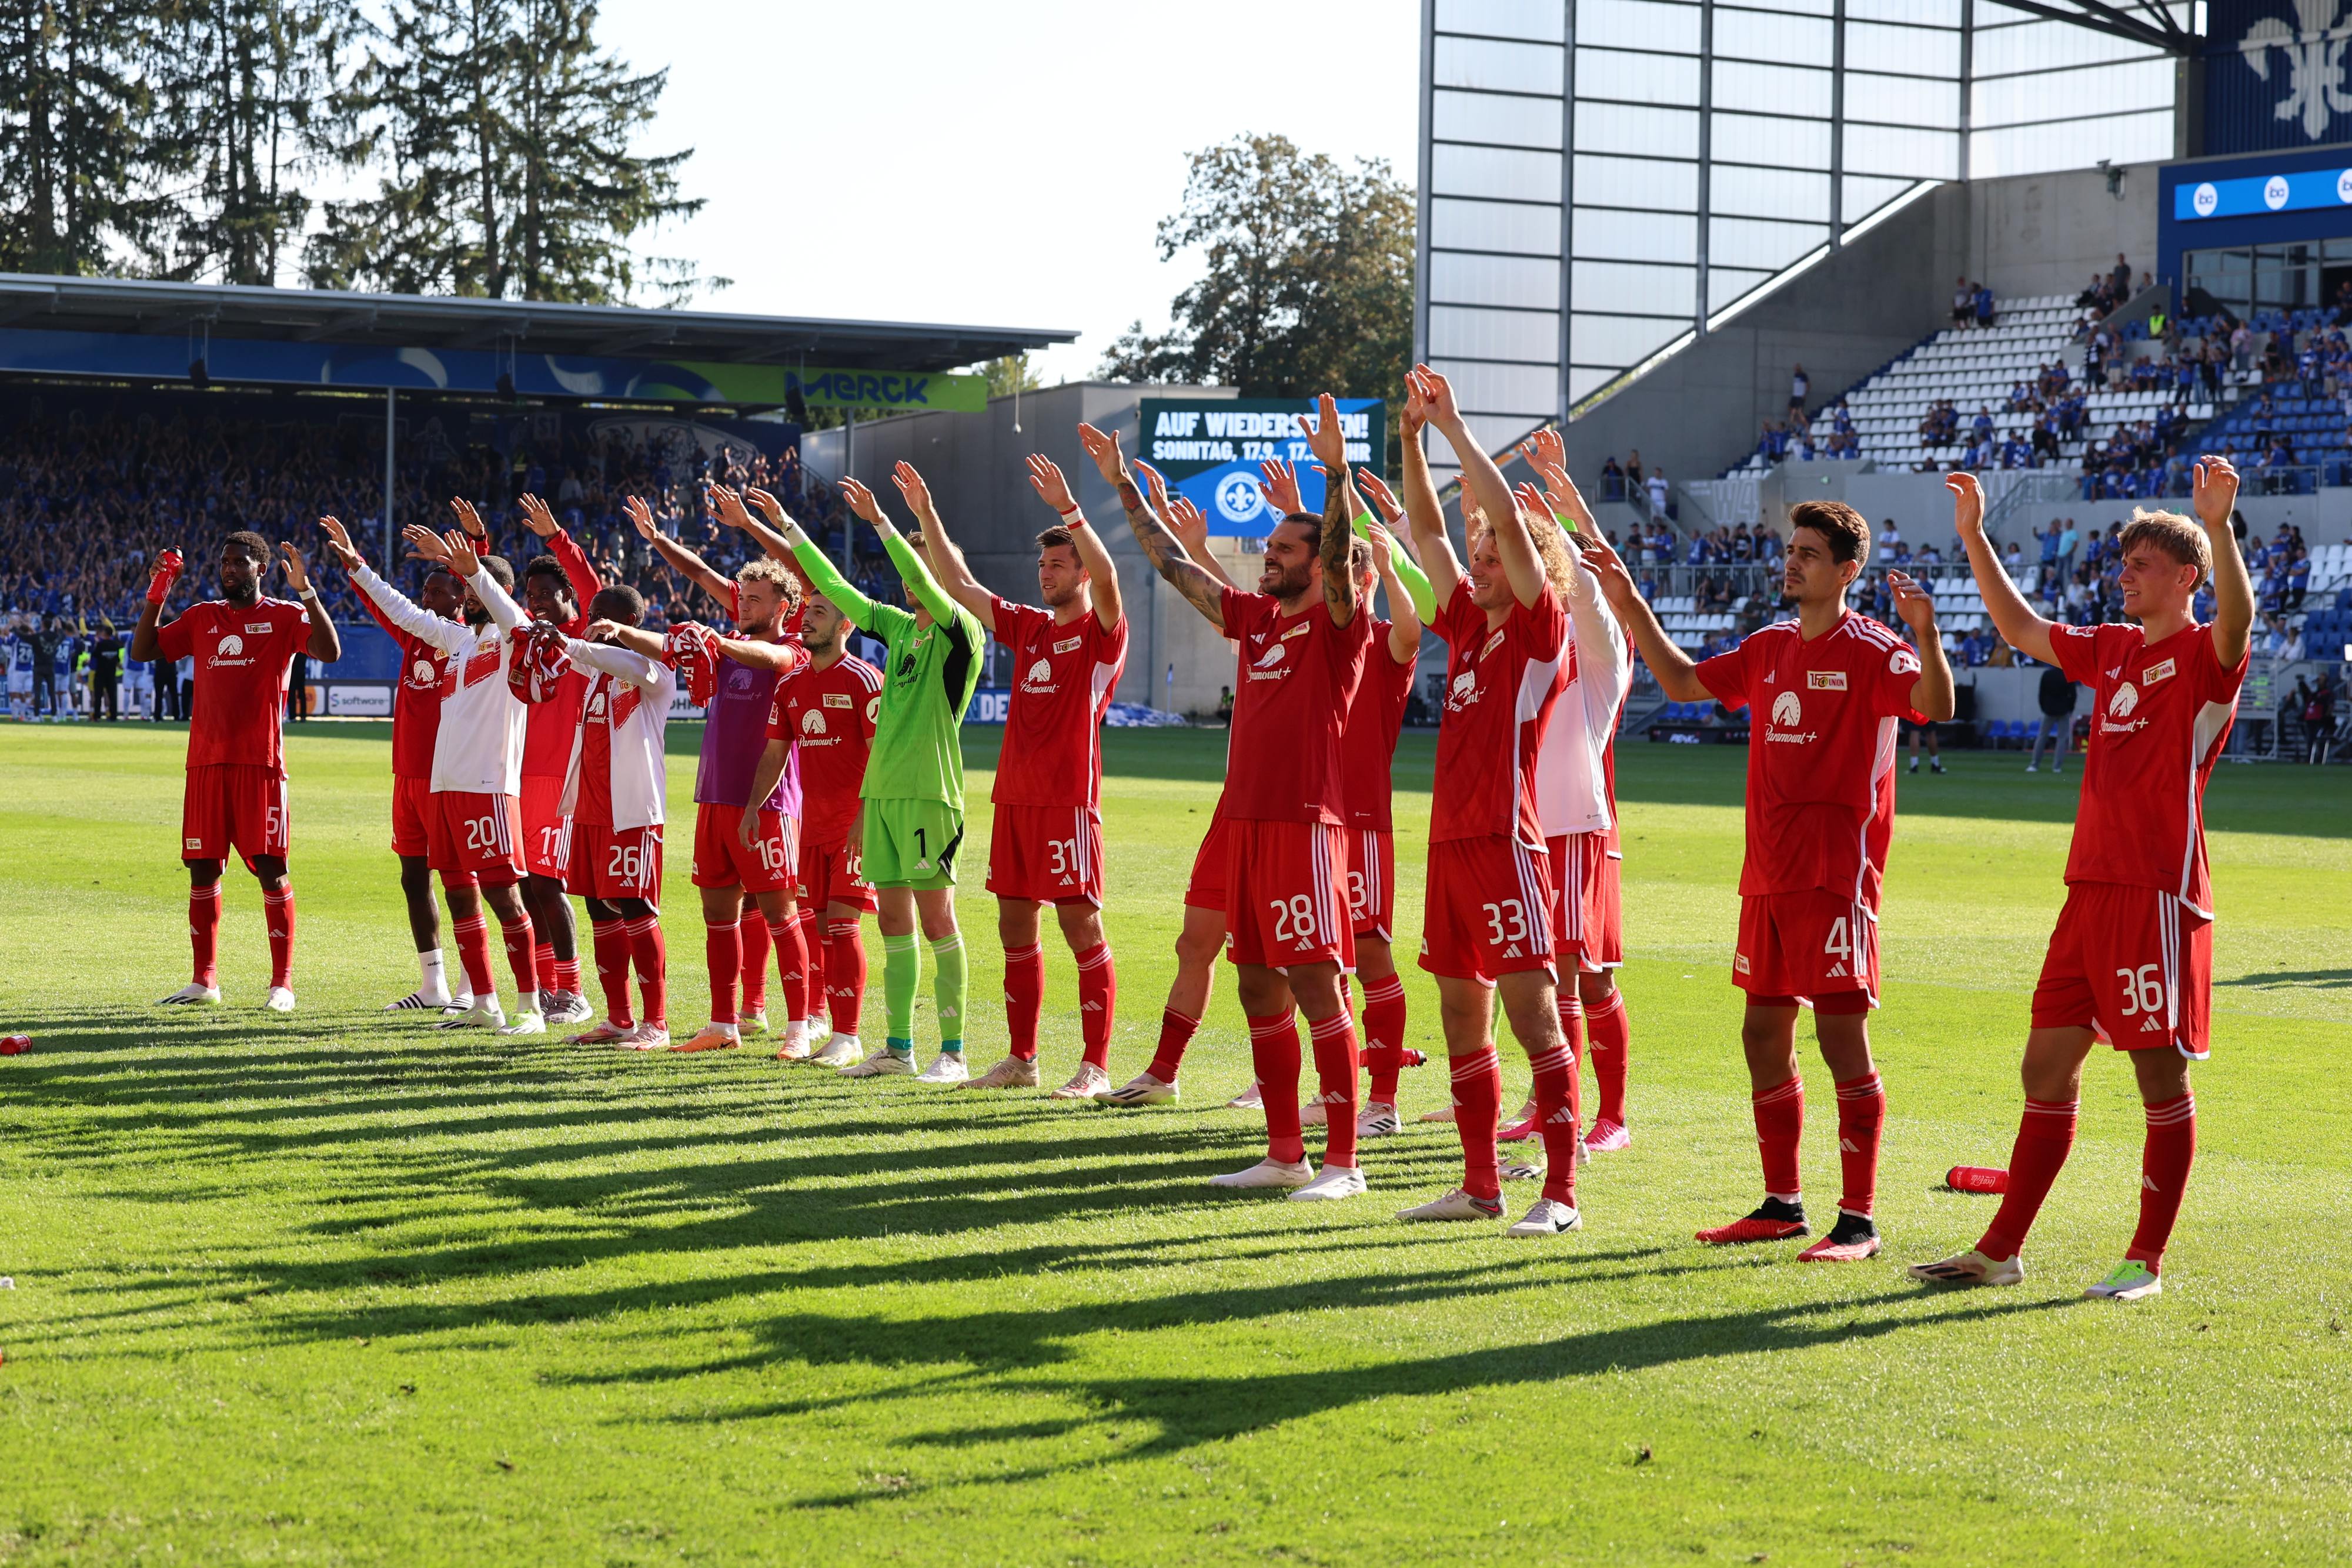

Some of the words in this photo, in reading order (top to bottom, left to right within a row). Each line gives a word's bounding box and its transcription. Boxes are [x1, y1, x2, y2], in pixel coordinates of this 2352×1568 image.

[1155, 412, 1200, 437] AUF
[1152, 441, 1237, 462] SONNTAG,
[1346, 443, 1371, 462] HR
[207, 656, 256, 669] Paramount+
[2160, 665, 2173, 676] UNION
[1829, 678, 1844, 687] UNION
[342, 696, 384, 706] software
[1765, 724, 1818, 745] Paramount+
[2099, 713, 2149, 736] Paramount+
[464, 816, 497, 850] 20
[540, 826, 562, 856] 11
[914, 828, 926, 858] 1
[608, 845, 639, 877] 26
[754, 837, 785, 870] 16
[1048, 838, 1078, 874] 31
[1270, 894, 1316, 942] 28
[1482, 899, 1528, 945] 33
[1825, 917, 1852, 961] 4
[2116, 963, 2164, 1016] 36
